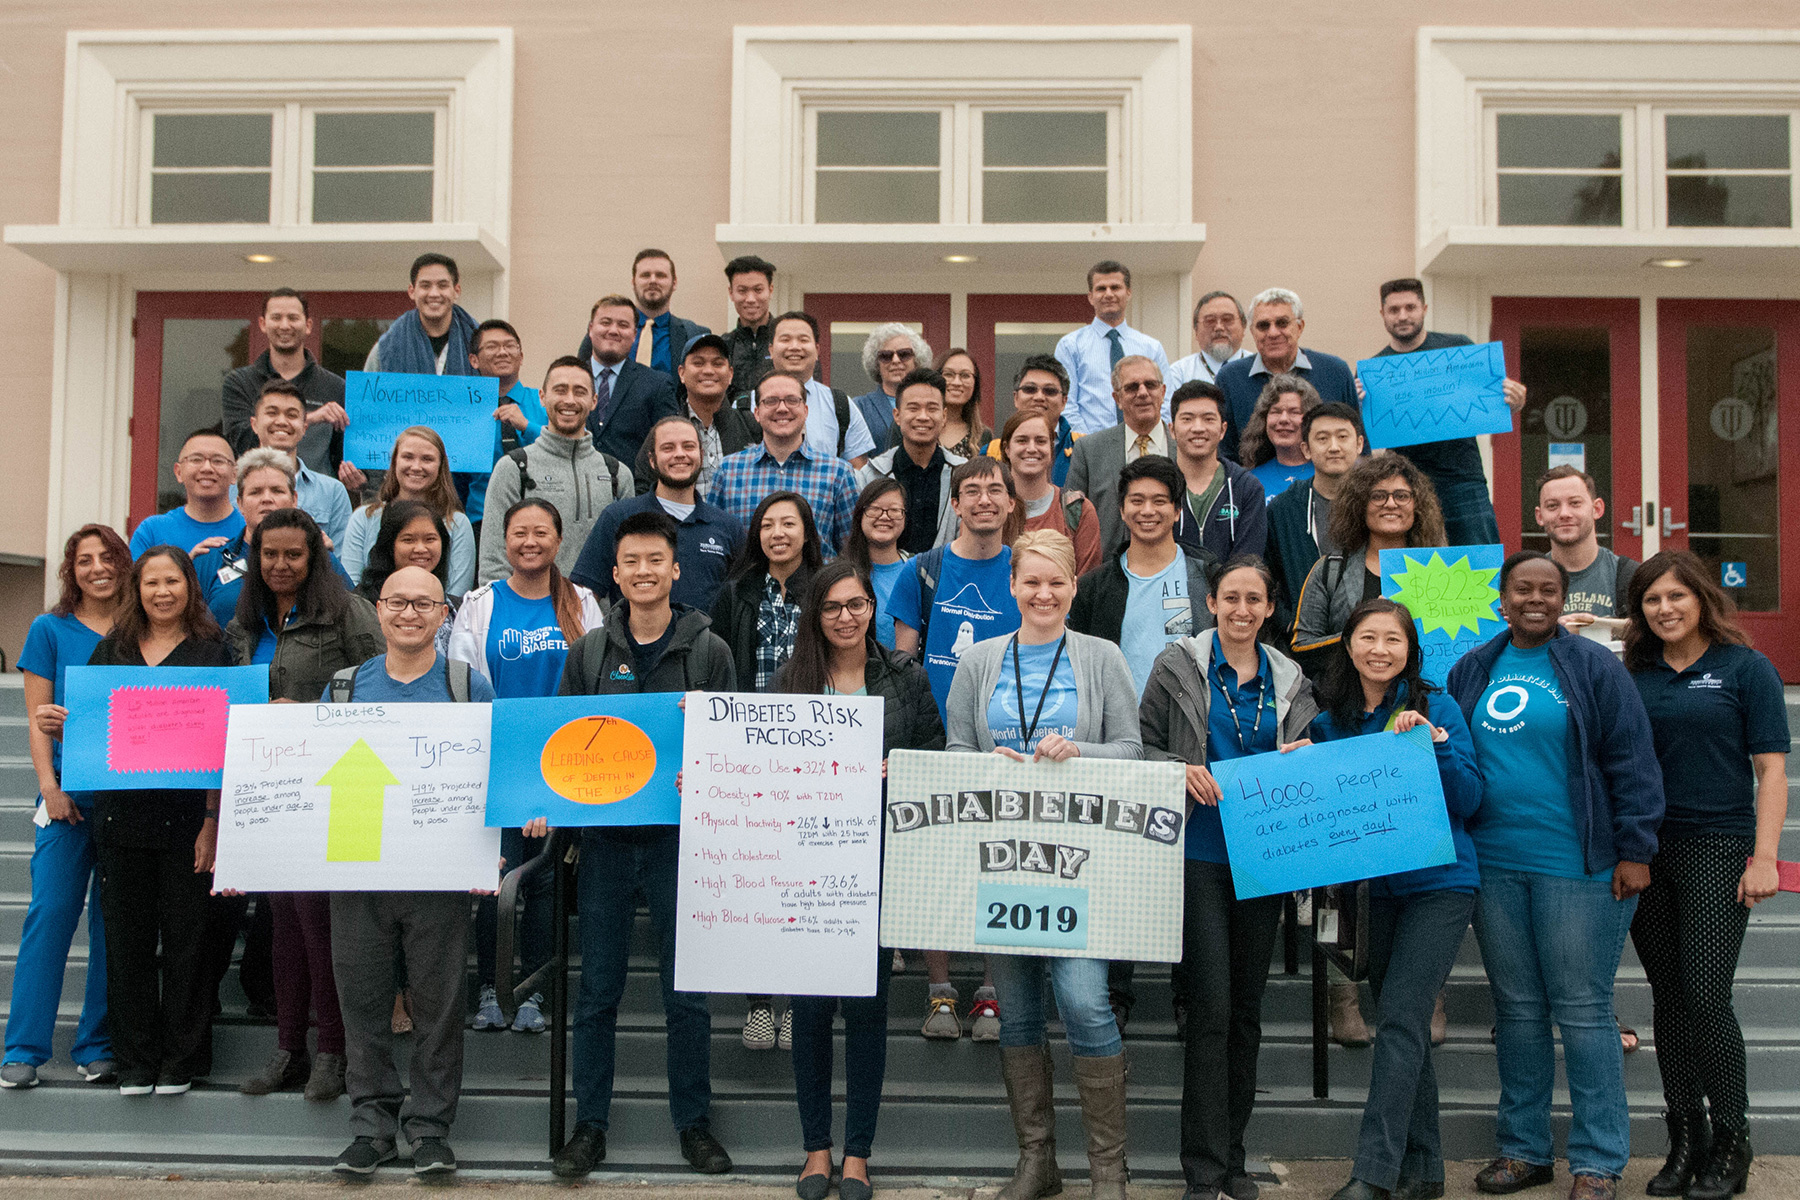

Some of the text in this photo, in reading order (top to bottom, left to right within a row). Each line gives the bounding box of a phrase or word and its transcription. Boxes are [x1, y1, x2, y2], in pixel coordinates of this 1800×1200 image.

[361, 376, 482, 404] NOVEMBER is
[351, 406, 471, 425] AMERICAN DIABETES
[1409, 569, 1489, 603] $622.3
[941, 606, 962, 615] Normal
[1425, 601, 1480, 618] BILLION
[1563, 602, 1592, 611] ODGE
[522, 626, 553, 636] TOGETHER
[522, 631, 550, 645] STOP
[522, 639, 569, 655] DIABETE
[316, 705, 386, 721] Diabetes
[584, 717, 617, 751] 7th
[745, 727, 834, 747] FACTORS:
[990, 726, 1017, 740] World
[1061, 724, 1075, 738] Da
[550, 749, 652, 767] LEADING CAUSE
[705, 752, 867, 776] Tobacco Use 32% risk
[235, 777, 303, 794] 23% Projected
[562, 772, 635, 783] OF DEATH IN
[411, 781, 482, 794] 49% Projected
[574, 787, 603, 798] THE
[1238, 777, 1314, 807] 4000
[234, 790, 301, 804] increase among
[447, 795, 473, 805] among
[708, 785, 844, 807] Obesity 90% with T2DM
[262, 804, 283, 812] under
[286, 803, 302, 812] age
[302, 802, 314, 810] 20
[441, 805, 461, 813] under
[465, 804, 480, 813] age
[1255, 792, 1418, 837] are diagnosed with
[235, 820, 245, 829] by
[413, 819, 424, 828] by
[701, 812, 878, 834] Physical Inactivity 26% in risk of
[890, 789, 1181, 845] DIABETES
[798, 831, 819, 839] T2DM
[822, 830, 838, 838] with
[1262, 812, 1394, 861] diabetes every day!
[838, 839, 849, 848] per
[701, 848, 727, 865] High
[984, 841, 1089, 879] DAY
[701, 873, 859, 898] High Blood Pressure 73.6%
[780, 888, 790, 898] of
[793, 889, 822, 898] adults
[826, 890, 844, 898] with
[800, 900, 815, 911] high
[839, 900, 867, 908] pressure
[696, 910, 718, 930] High
[721, 909, 749, 924] Blood
[753, 912, 786, 925] Glucose
[986, 902, 1079, 933] 2019
